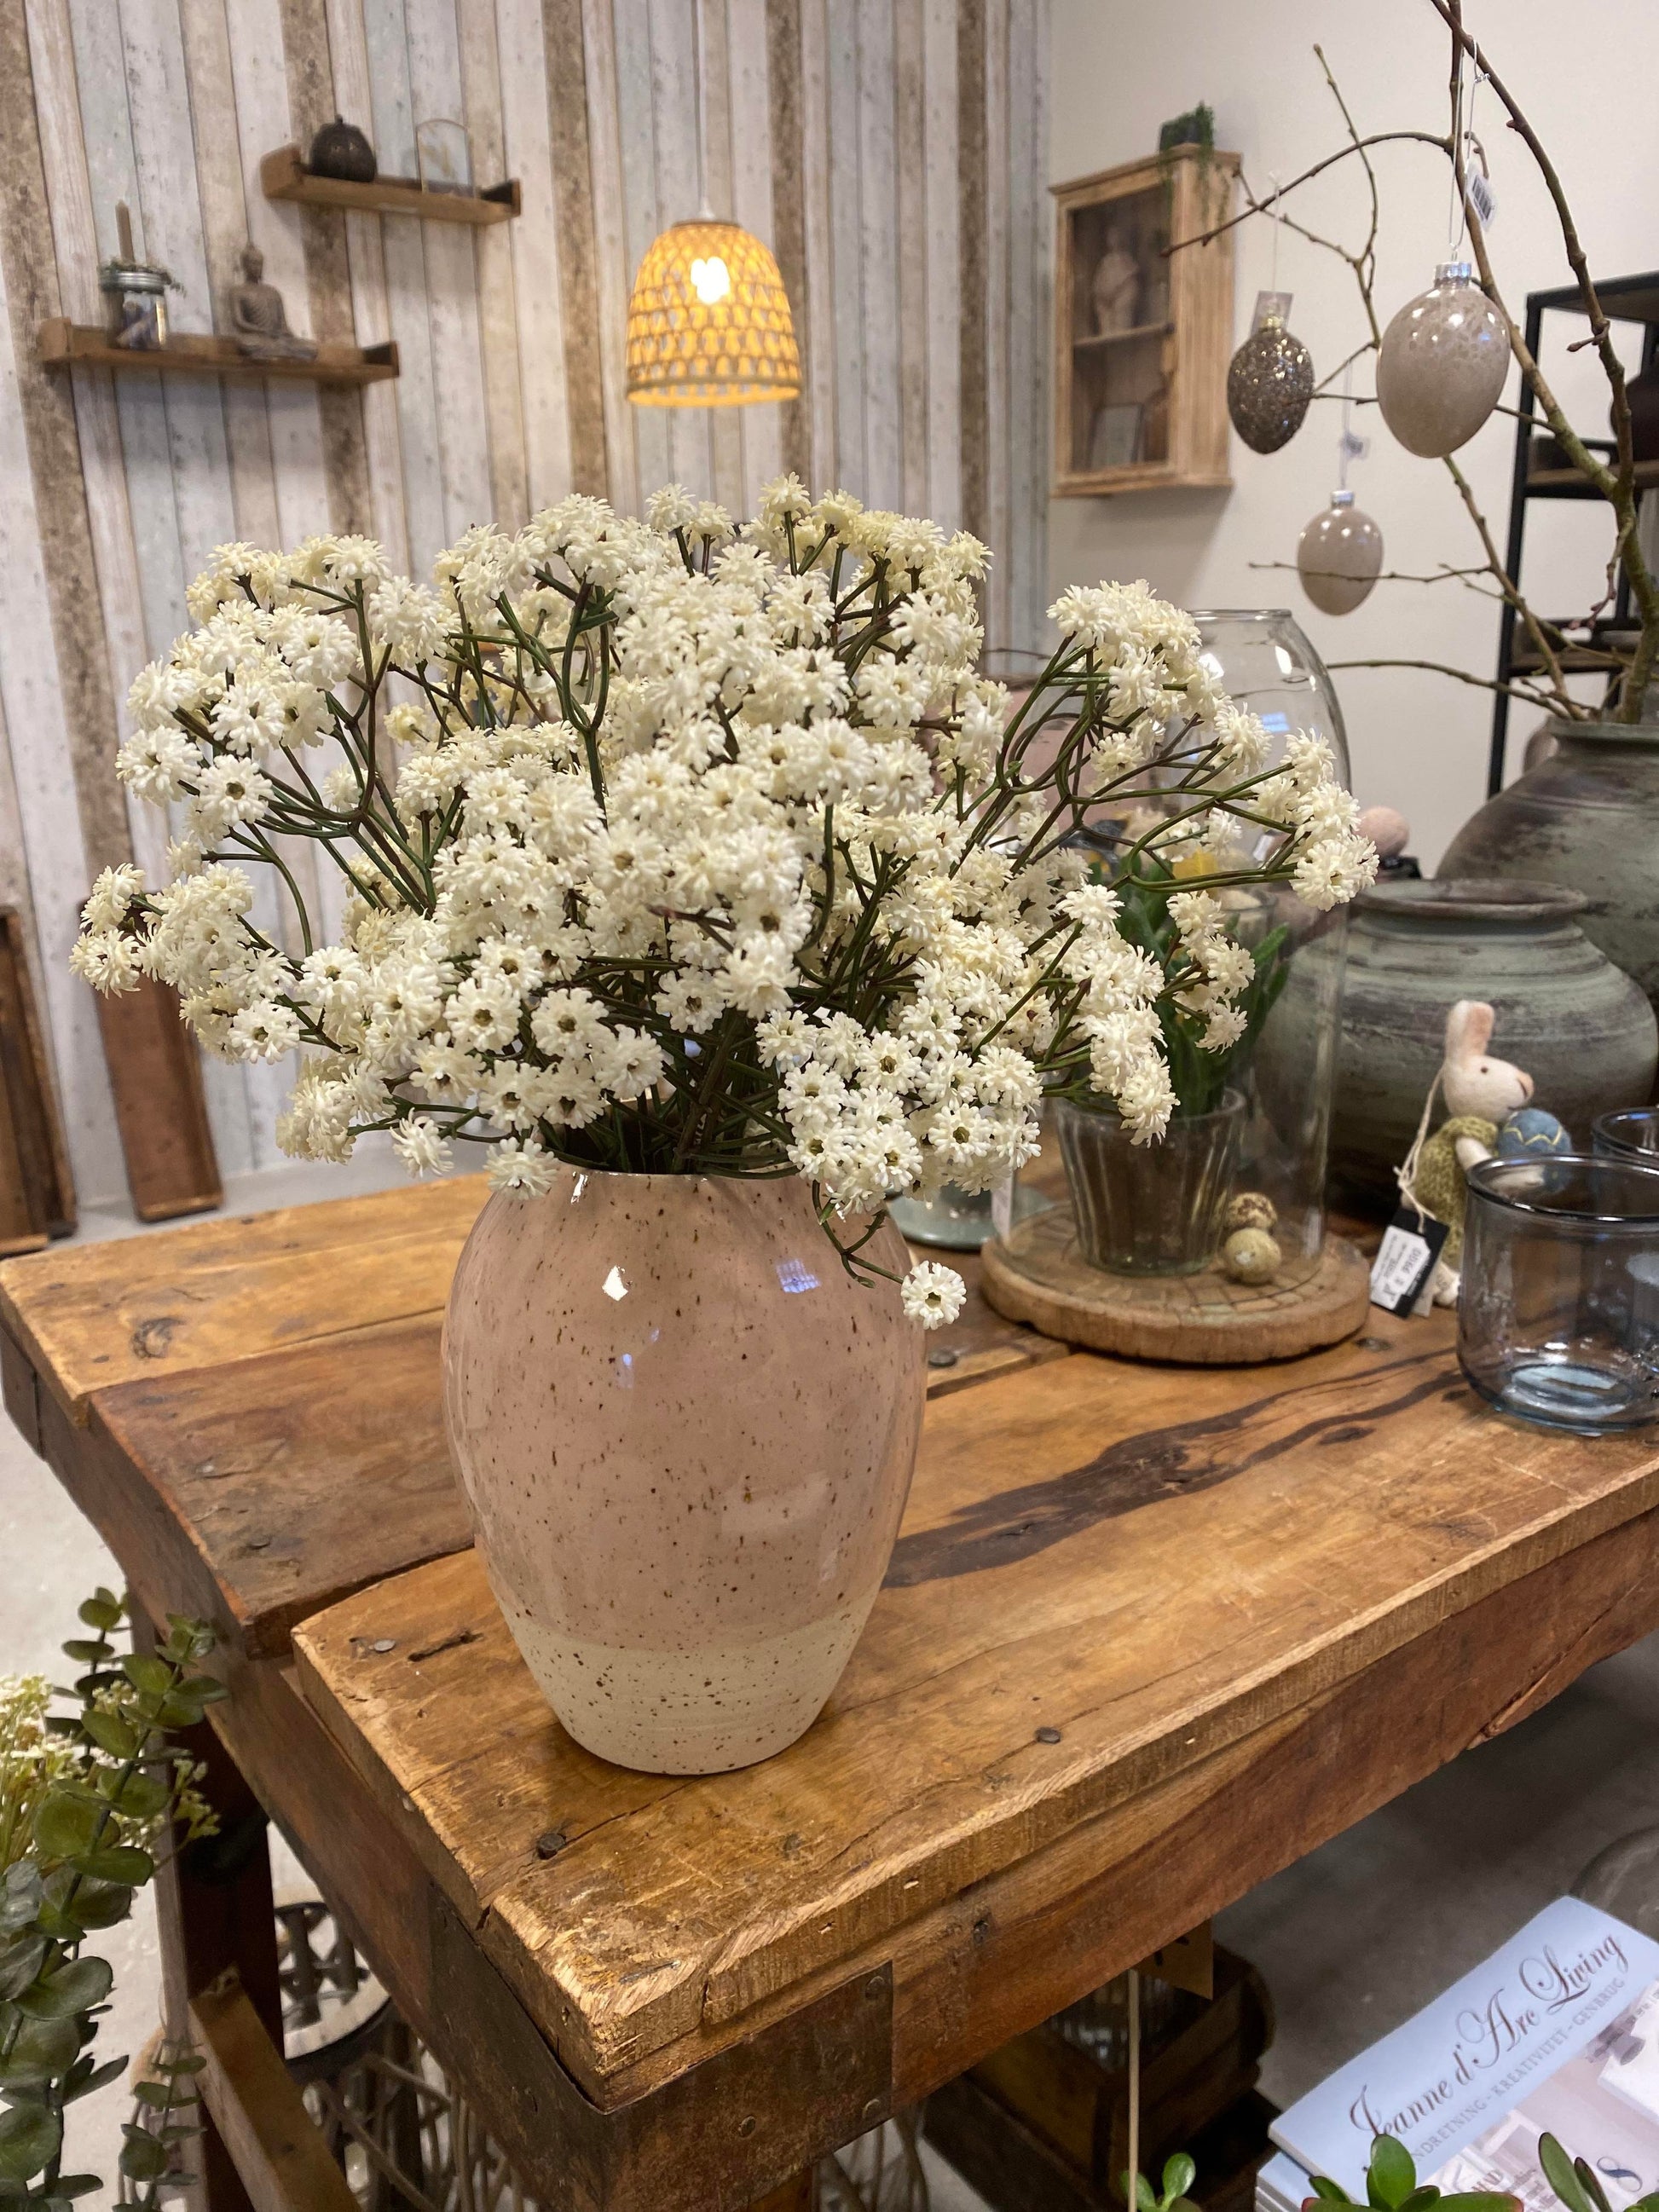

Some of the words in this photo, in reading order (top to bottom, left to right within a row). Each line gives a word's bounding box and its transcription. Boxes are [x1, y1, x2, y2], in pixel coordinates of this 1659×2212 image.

[1350, 2084, 1454, 2172] Jeanne
[1453, 1989, 1540, 2086] d'Arc
[1518, 1935, 1629, 2014] Living
[1410, 2099, 1487, 2163] NDRETNING
[1492, 2029, 1569, 2096] KREATIVITET
[1573, 1977, 1625, 2026] GENBRUG
